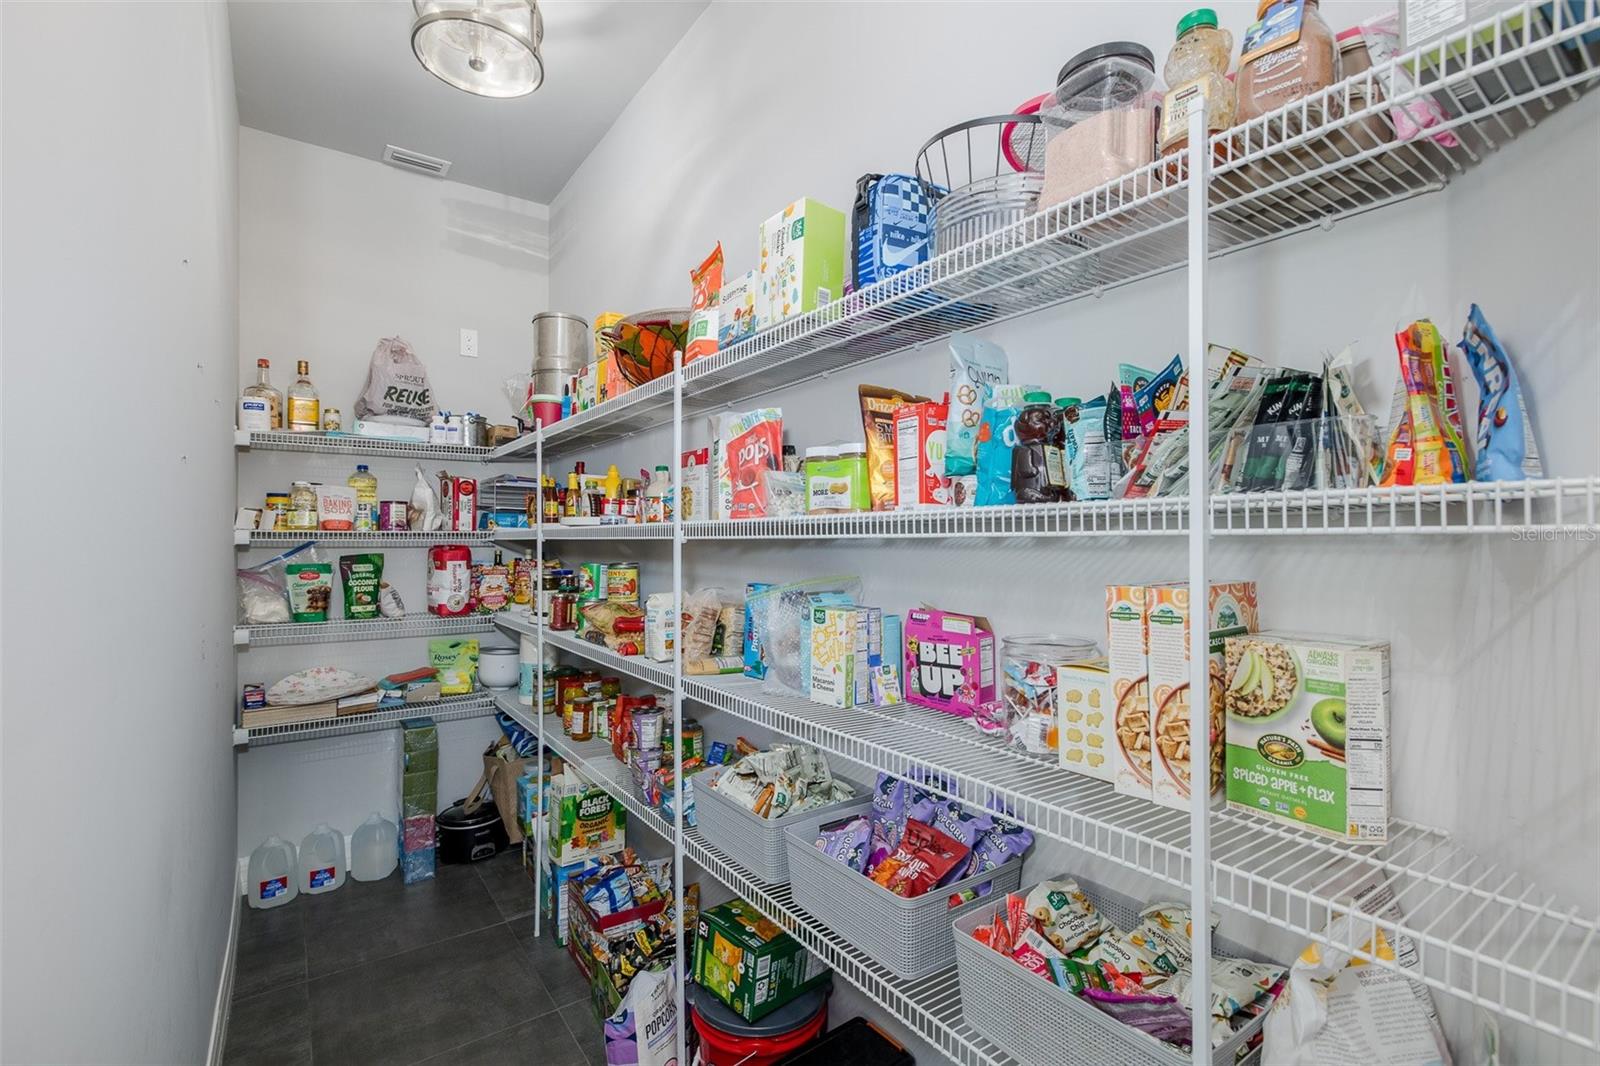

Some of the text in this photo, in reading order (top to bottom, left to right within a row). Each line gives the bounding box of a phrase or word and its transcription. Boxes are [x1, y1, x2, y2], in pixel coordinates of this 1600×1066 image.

[967, 364, 1001, 389] Quinn
[382, 385, 431, 407] REUSE
[812, 488, 829, 496] MORE
[323, 498, 352, 508] BAKING
[324, 507, 352, 515] SODA
[751, 626, 759, 652] PROT
[1209, 637, 1225, 646] CASCA
[918, 641, 964, 666] BEE
[1308, 650, 1339, 662] ALWAYS
[1306, 659, 1339, 667] ORGANIC
[812, 676, 835, 686] Macaroni
[920, 665, 965, 697] UP
[816, 683, 835, 693] Cheese
[1259, 734, 1303, 754] NATURE'S PATH
[1267, 756, 1293, 767] ORGANIC
[1255, 764, 1309, 783] GLUTEN FREE
[581, 795, 609, 809] BLACK
[579, 803, 612, 817] FOREST
[579, 817, 610, 829] ORGANIC
[1058, 913, 1088, 930] Chocolate
[1070, 921, 1085, 932] Chip
